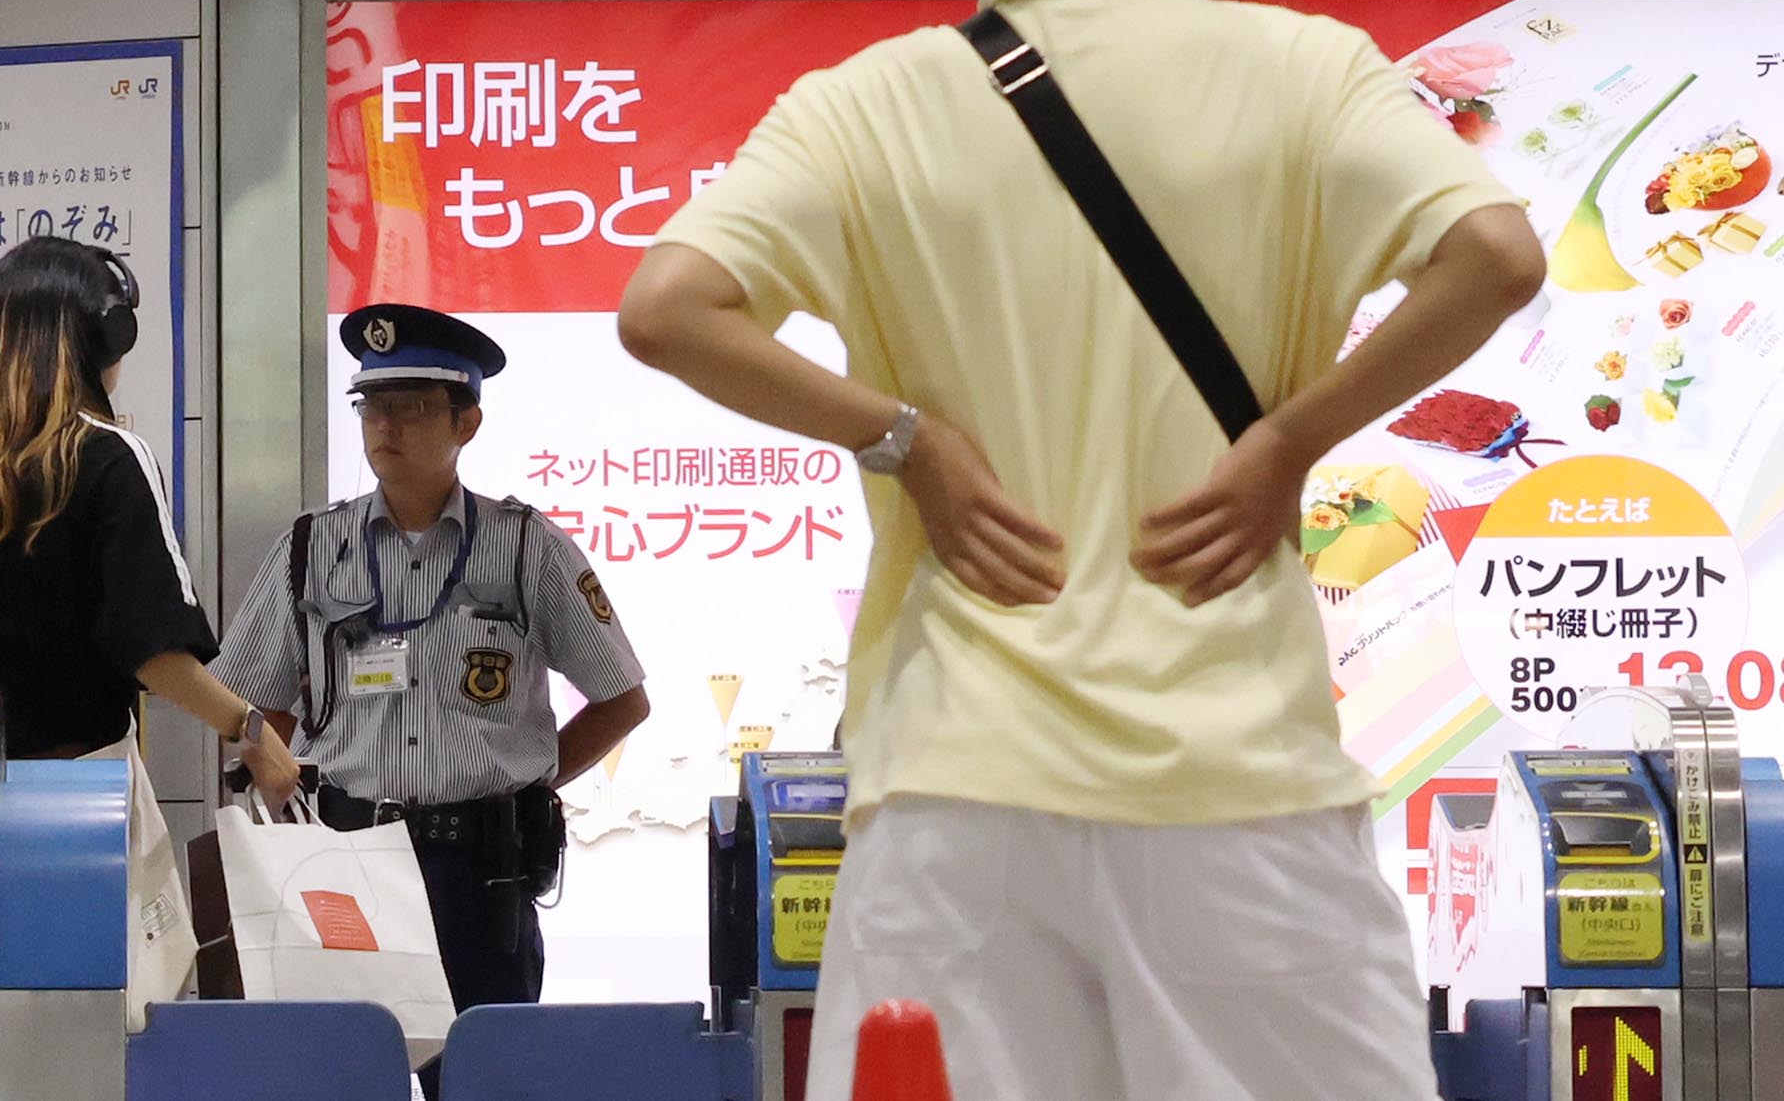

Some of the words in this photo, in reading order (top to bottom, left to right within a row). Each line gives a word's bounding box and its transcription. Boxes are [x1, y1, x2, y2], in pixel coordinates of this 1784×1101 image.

[1756, 51, 1784, 78] デ
[111, 79, 130, 96] JR
[138, 78, 158, 94] JR
[380, 57, 642, 149] 印刷を
[443, 160, 730, 250] もっと
[526, 446, 842, 488] ネット印刷通販の
[1547, 497, 1651, 524] たとえば
[1479, 554, 1727, 600] パンフレット
[1510, 656, 1556, 683] 8P
[1510, 686, 1586, 713] 500
